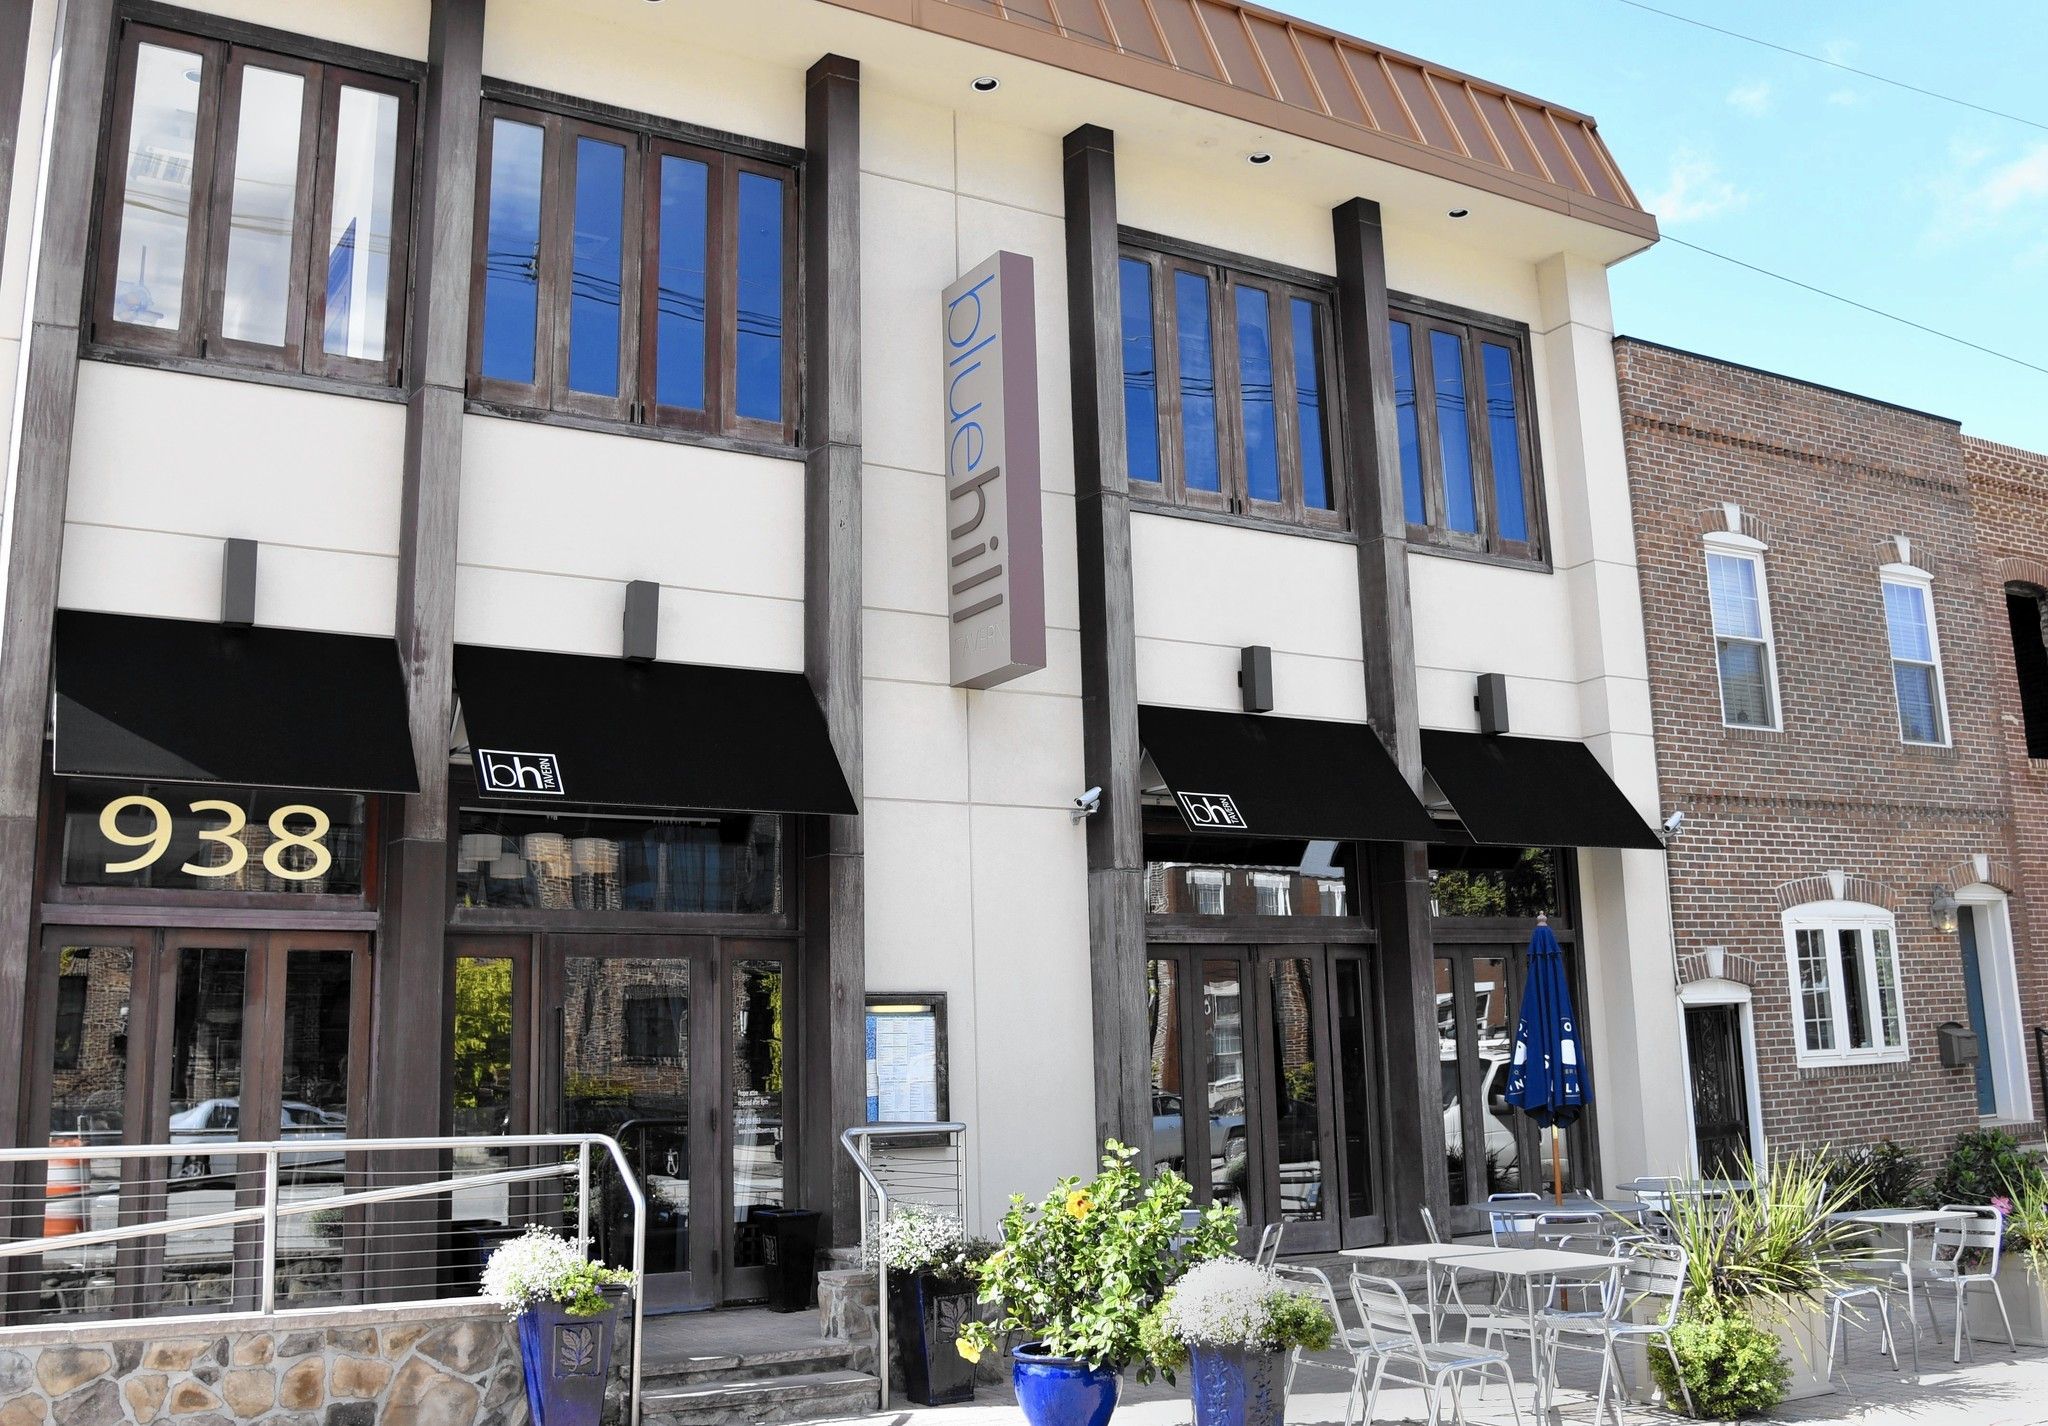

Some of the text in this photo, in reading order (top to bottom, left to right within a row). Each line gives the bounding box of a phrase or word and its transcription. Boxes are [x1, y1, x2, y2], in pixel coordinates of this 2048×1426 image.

[953, 620, 1009, 657] TAVERN
[486, 754, 544, 789] bh
[539, 757, 556, 789] TAVERN
[1184, 795, 1232, 823] bh
[1219, 798, 1240, 824] TAVERN
[99, 795, 332, 880] 938
